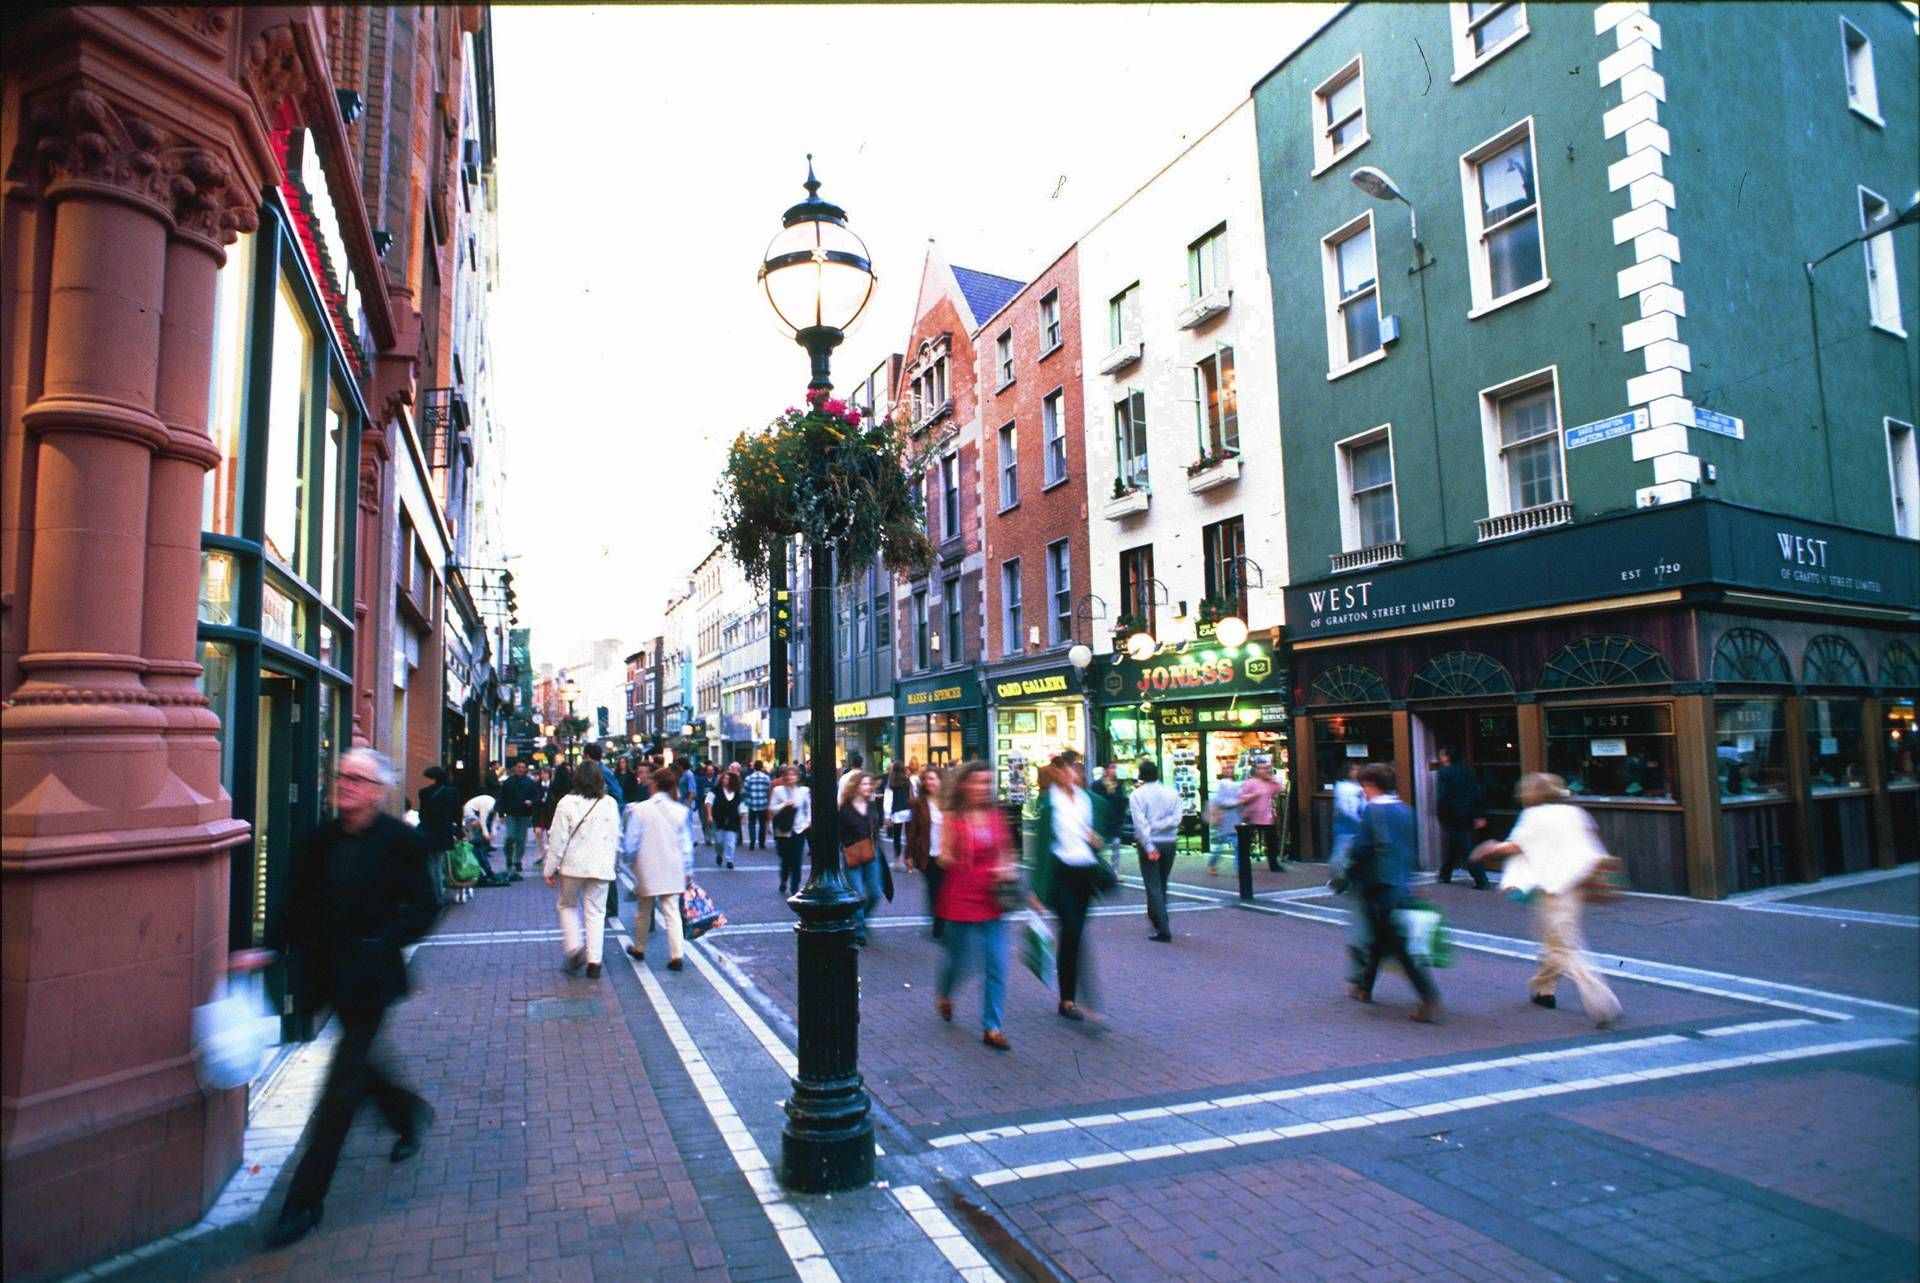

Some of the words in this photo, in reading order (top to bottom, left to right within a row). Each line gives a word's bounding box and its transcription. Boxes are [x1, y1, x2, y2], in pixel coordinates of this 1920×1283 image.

[1638, 414, 1646, 424] 2
[1777, 532, 1828, 568] WEST
[1621, 568, 1641, 581] EST
[1654, 563, 1681, 575] 1720
[1308, 581, 1372, 613] WEST
[1310, 619, 1321, 628] OF
[1326, 612, 1368, 626] GRAFTON
[1372, 605, 1407, 619] STREET
[1412, 597, 1456, 613] LIMITED
[1250, 662, 1265, 673] 32
[1022, 675, 1067, 694] GALLERY
